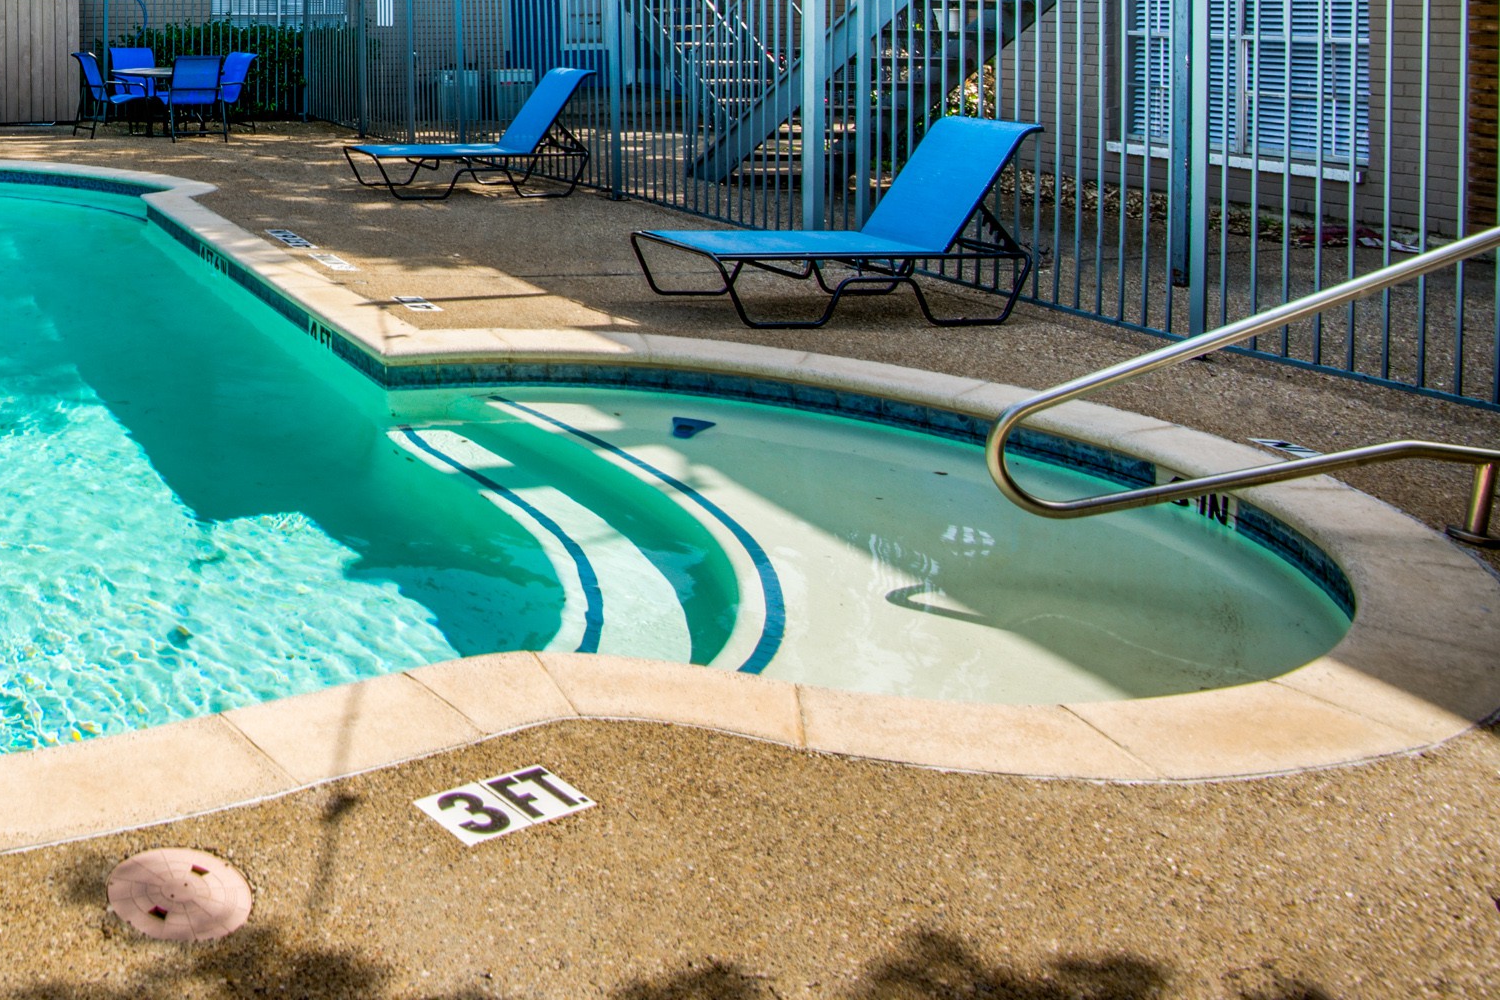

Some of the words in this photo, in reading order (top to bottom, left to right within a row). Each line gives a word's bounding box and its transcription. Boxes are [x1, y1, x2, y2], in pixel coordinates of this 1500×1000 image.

[310, 320, 318, 341] 4
[320, 324, 331, 350] FT
[436, 791, 511, 834] 3
